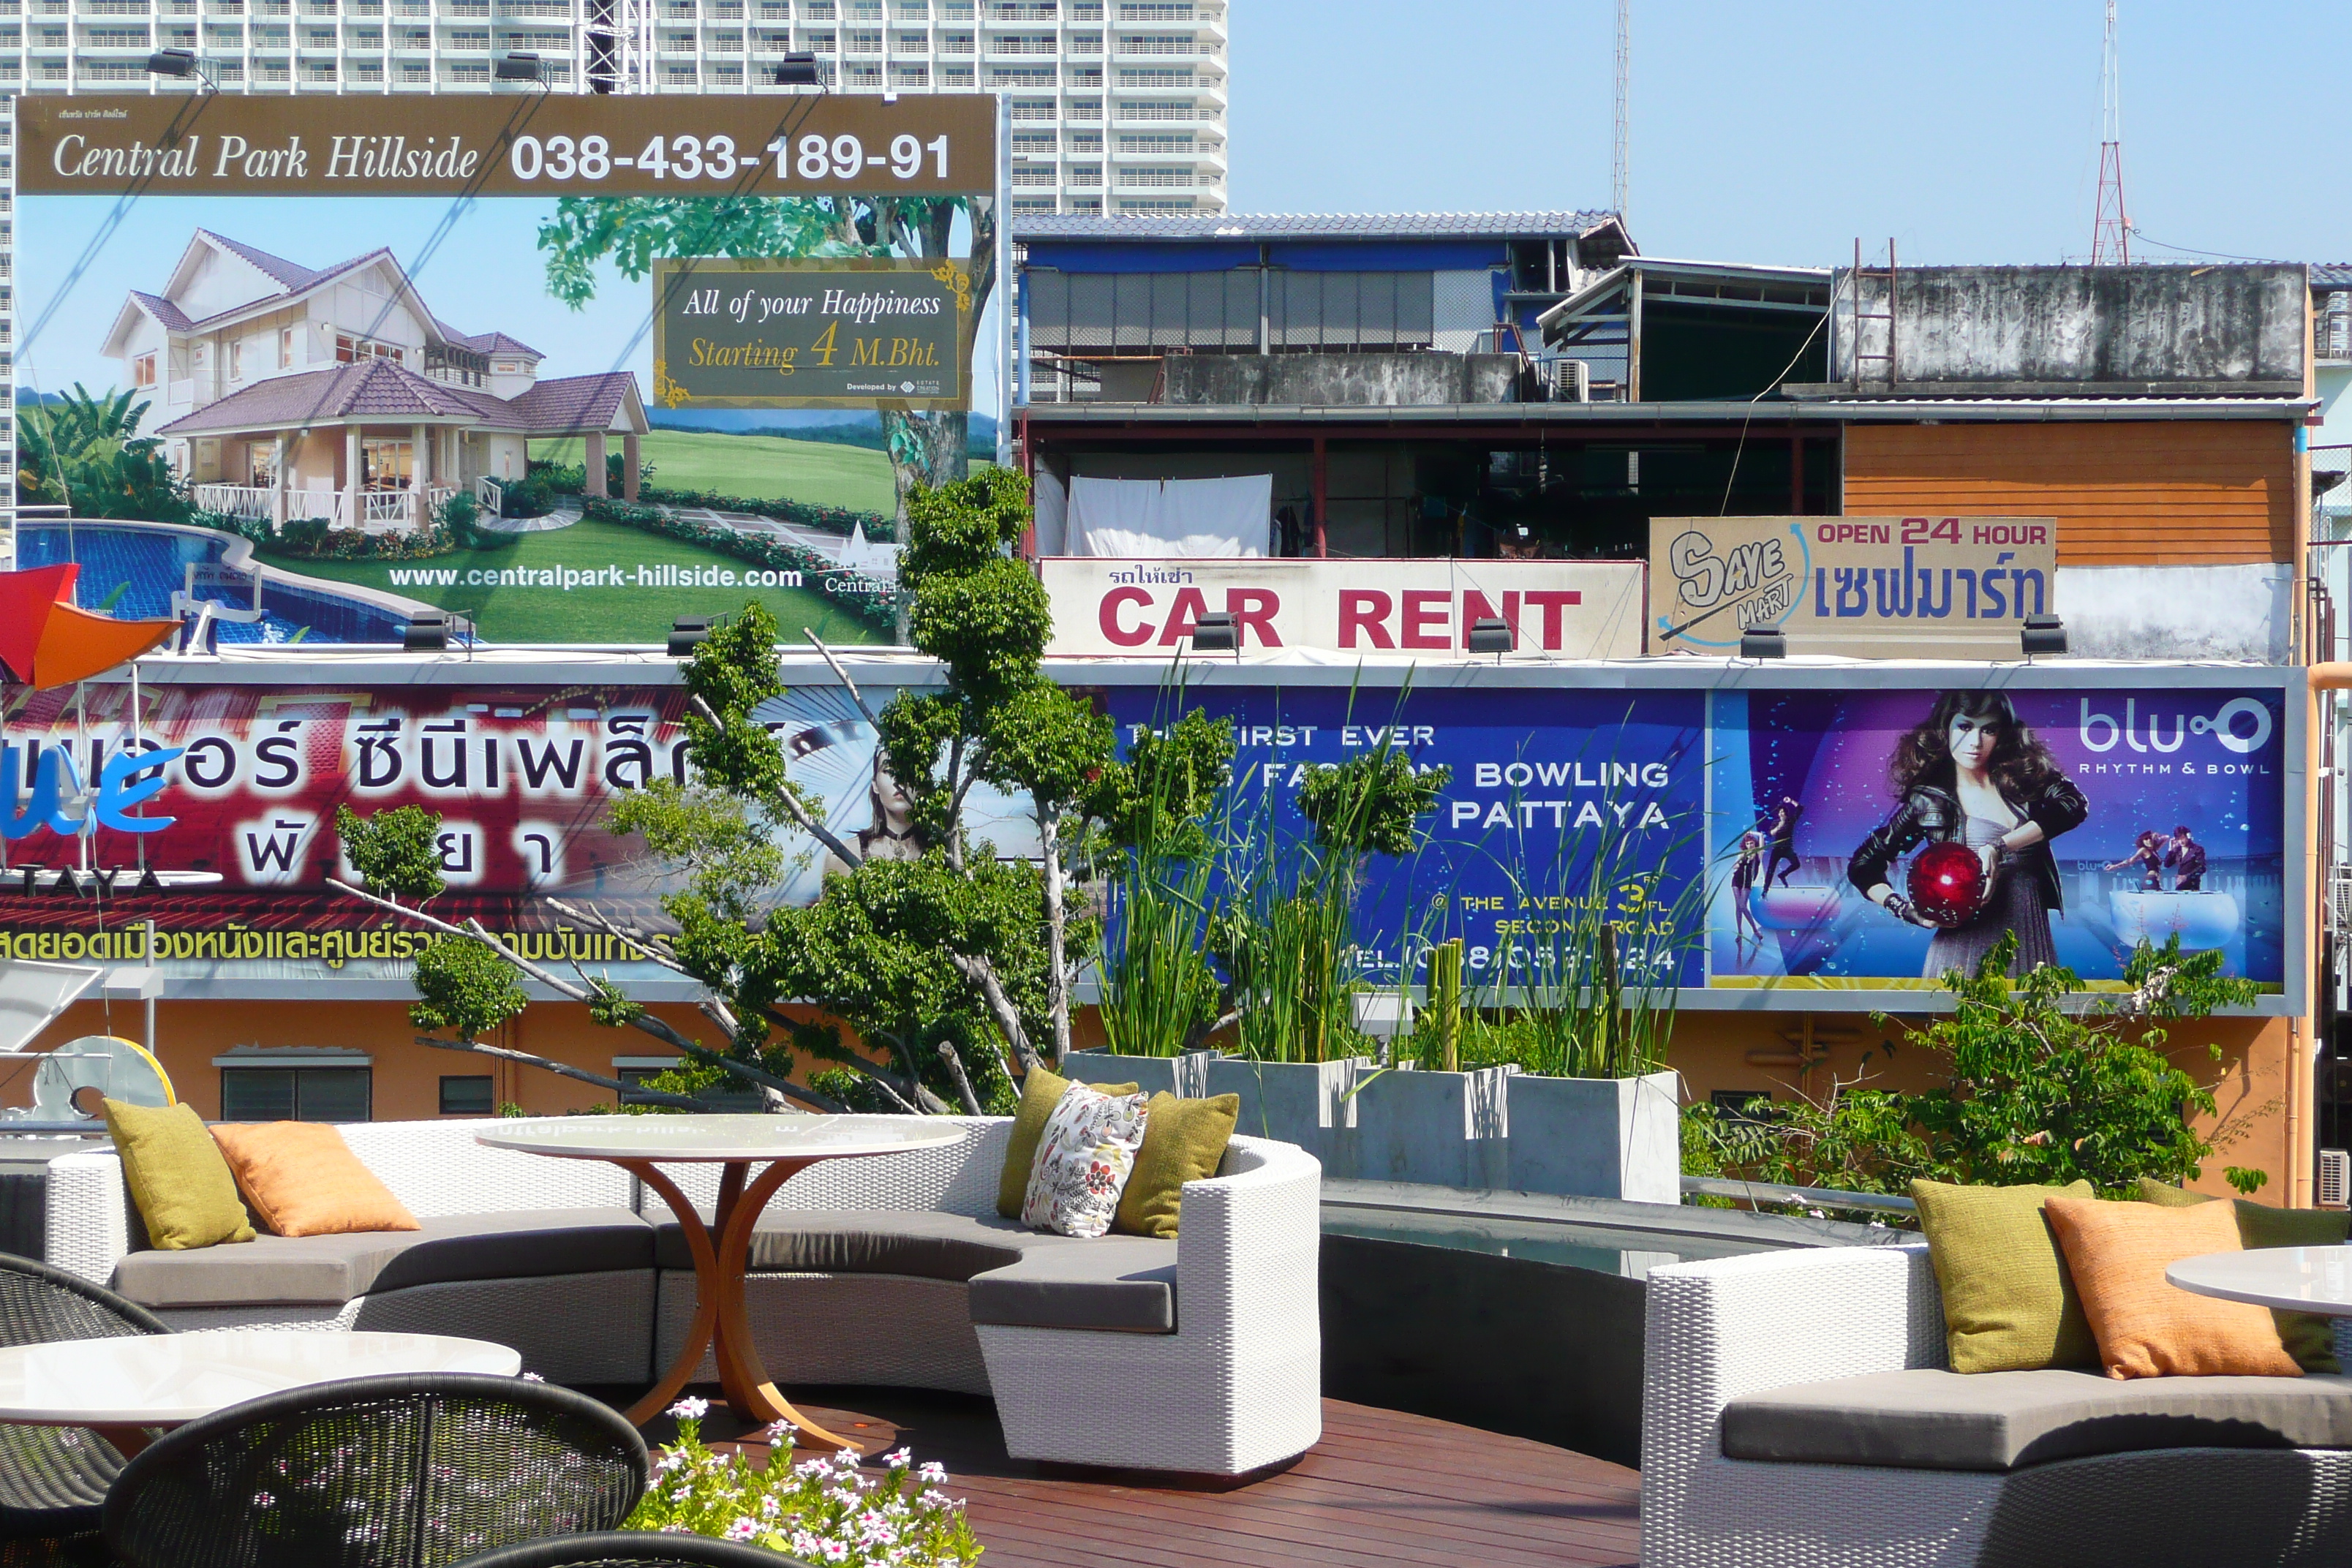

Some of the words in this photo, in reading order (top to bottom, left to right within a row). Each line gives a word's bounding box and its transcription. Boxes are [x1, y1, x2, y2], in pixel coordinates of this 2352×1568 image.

[53, 135, 198, 177] Central
[213, 135, 308, 177] Park
[325, 135, 479, 178] Hillside
[512, 135, 949, 179] 038-433-189-91
[683, 290, 720, 314] All
[729, 290, 754, 323] of
[758, 296, 812, 323] your
[820, 289, 941, 323] Happiness
[689, 338, 799, 375] Starting
[810, 320, 839, 366] 4
[849, 338, 940, 366] M.Bht.
[847, 383, 885, 392] Developed
[887, 383, 897, 392] by
[1817, 524, 1890, 544] OPEN
[1901, 518, 1963, 545] 24
[1973, 525, 2046, 545] HOUR
[389, 564, 802, 590] www.centralpark-hillside.com
[1109, 565, 1193, 584] รถให้เช่า
[1670, 531, 1785, 608] SAVE
[1736, 573, 1794, 630] MART
[1098, 586, 1284, 648] CAR
[1338, 587, 1582, 650] RENT
[1229, 725, 1318, 746] IRST
[1341, 725, 1433, 746] EVER
[1475, 762, 1669, 788] BOWLING
[2079, 764, 2171, 774] RHYTHM
[2182, 762, 2195, 774] &
[2207, 764, 2270, 774] BOWL
[1452, 801, 1670, 829] PATTAYA
[1461, 897, 1504, 910] THE
